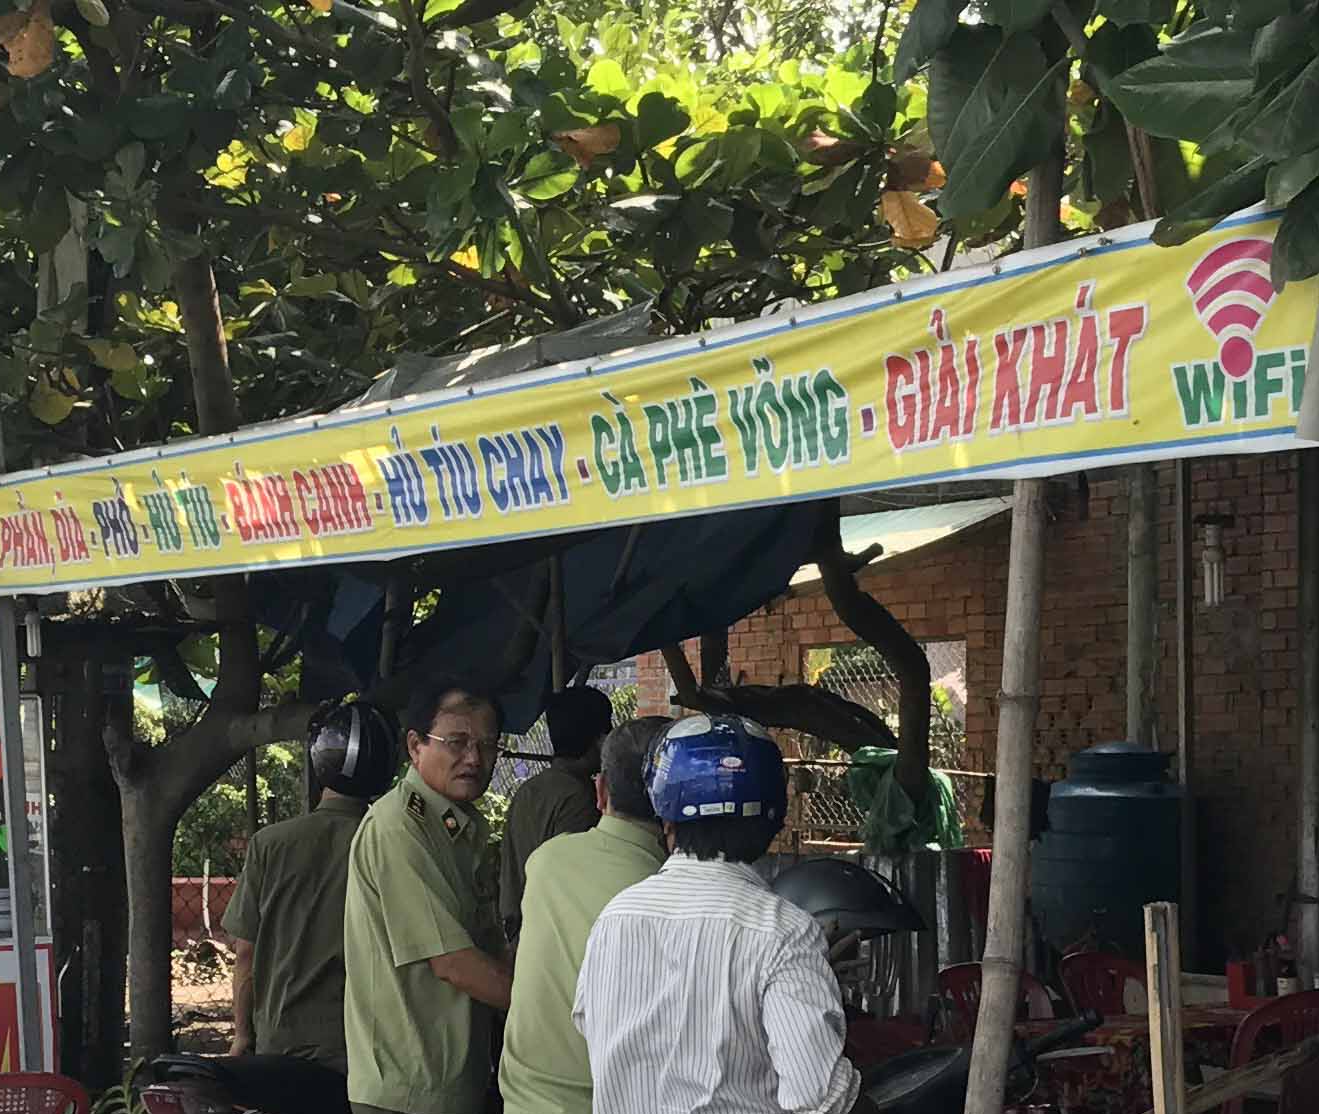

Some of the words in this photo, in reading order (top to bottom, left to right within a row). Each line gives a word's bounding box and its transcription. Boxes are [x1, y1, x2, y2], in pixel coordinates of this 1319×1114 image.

[225, 461, 300, 541] BÁNH
[292, 463, 373, 536] CANH
[379, 426, 428, 525] HỦ
[479, 425, 569, 512] CHAY
[591, 391, 647, 494] CÀ
[642, 377, 727, 485] PHÊ
[728, 357, 848, 471] VÕNG
[886, 309, 979, 449] GIẢI
[990, 285, 1144, 429] KHÁT
